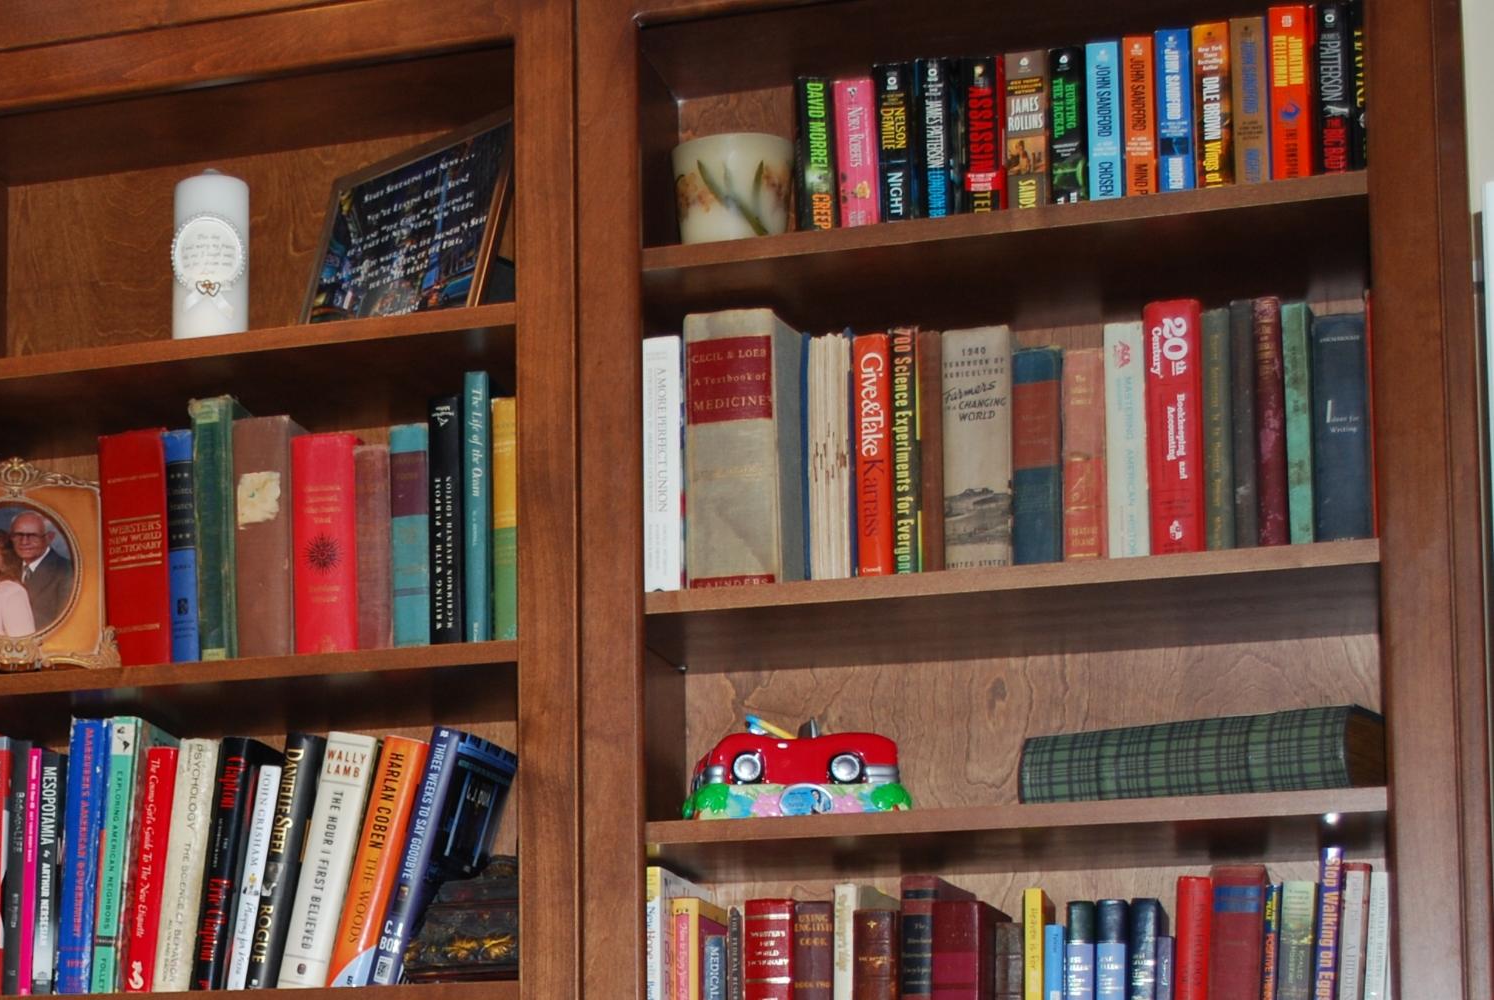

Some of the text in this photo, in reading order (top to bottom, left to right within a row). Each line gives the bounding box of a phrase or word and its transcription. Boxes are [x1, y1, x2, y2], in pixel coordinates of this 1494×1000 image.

[1163, 48, 1181, 120] JOHN SANDFORD
[1273, 35, 1288, 86] KELLERMAN
[1289, 37, 1303, 84] JONATHAN
[1320, 41, 1343, 101] PATTERSON
[807, 83, 826, 117] DAVID
[1011, 97, 1038, 115] JAMES
[1066, 83, 1079, 129] HUNTING
[1096, 65, 1112, 137] JOHN SANDFORD
[1130, 58, 1147, 131] JOHN SANDFORD
[1203, 76, 1220, 101] DALE
[882, 108, 895, 150] DEMILLE
[895, 107, 906, 148] NELSON
[969, 87, 993, 171] ASSASSIN
[1008, 113, 1043, 131] ROLLINS
[1053, 101, 1064, 138] JACKAL
[1204, 103, 1221, 140] BROWN
[925, 100, 946, 208] JAMES PATTERSON LONDON
[1134, 163, 1148, 187] MIND
[1203, 142, 1222, 171] Wings
[887, 172, 904, 215] NIGHT
[1099, 162, 1115, 196] CHOSEN
[813, 193, 832, 228] CREEP
[1151, 326, 1165, 376] Century
[471, 388, 483, 408] The
[693, 396, 768, 412] MEDICINE
[893, 356, 913, 407] Science
[958, 396, 1008, 411] CHANGING
[471, 410, 483, 432] Life
[958, 410, 997, 422] WORLD
[1166, 405, 1179, 461] Accounting
[1175, 393, 1189, 479] Bookkeeping and
[471, 434, 483, 447] of
[471, 447, 483, 464] the
[891, 411, 914, 492] Experiments
[434, 477, 442, 526] PURPOSE
[862, 459, 885, 537] Karrass
[896, 496, 914, 514] for
[435, 544, 443, 574] WITH
[435, 579, 443, 630] WRITING
[327, 749, 368, 764] WALLY
[327, 761, 361, 778] LAMB
[381, 752, 405, 802] HARLAN
[112, 770, 124, 823] EXPLORING
[186, 743, 204, 830] PSYCHOLOGY
[271, 748, 304, 854] DANIELLE STEEL
[40, 766, 57, 897] MESOPOTAMIA ARTHUR
[250, 773, 271, 866] JOHN GRISHAM
[369, 806, 391, 850] COBEN
[401, 743, 447, 880] THREE WEEKS TO SAY GOODBYE
[108, 825, 119, 875] AMERICAN
[300, 790, 344, 950] THE HOUR FIRST BELIEVED
[252, 904, 274, 964] ROGUE
[347, 889, 371, 945] WOODS
[1319, 892, 1340, 946] Walking
[379, 936, 402, 954] BOX
[1320, 951, 1335, 968] on
[709, 946, 720, 998] MEDICAL
